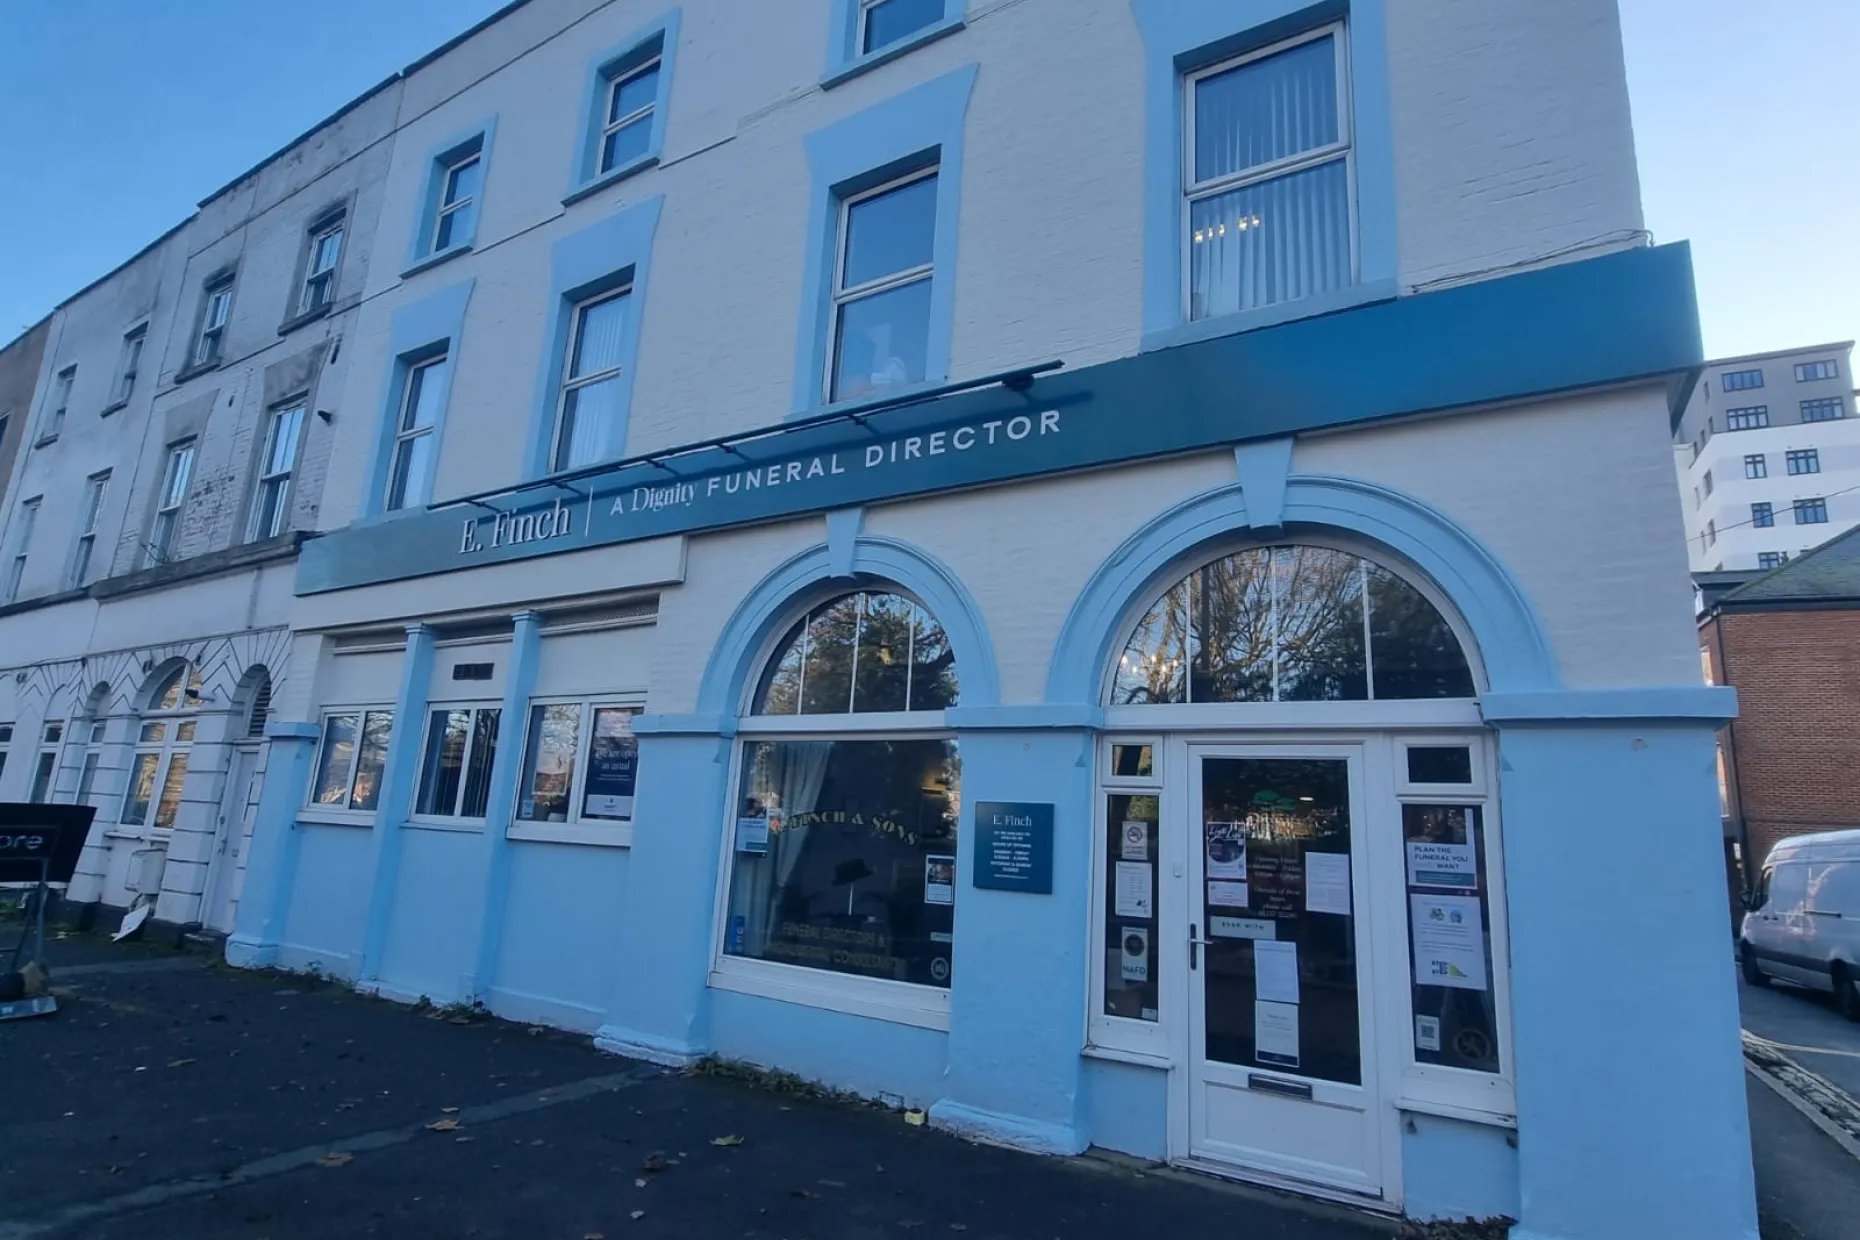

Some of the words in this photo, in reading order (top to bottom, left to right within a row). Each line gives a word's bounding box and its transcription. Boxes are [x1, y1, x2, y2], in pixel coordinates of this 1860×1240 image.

[610, 497, 624, 516] A
[631, 482, 698, 512] Dignity
[706, 453, 846, 497] FUNERAL
[865, 409, 1061, 468] DIRECTOR
[460, 519, 484, 553] E.
[491, 496, 572, 548] Finch
[872, 815, 919, 846] SONS
[1414, 845, 1435, 853] PLAN
[1436, 846, 1451, 854] THE
[1414, 853, 1451, 862] FUNERAL
[1452, 855, 1469, 863] YOU
[1122, 963, 1146, 975] NAFD
